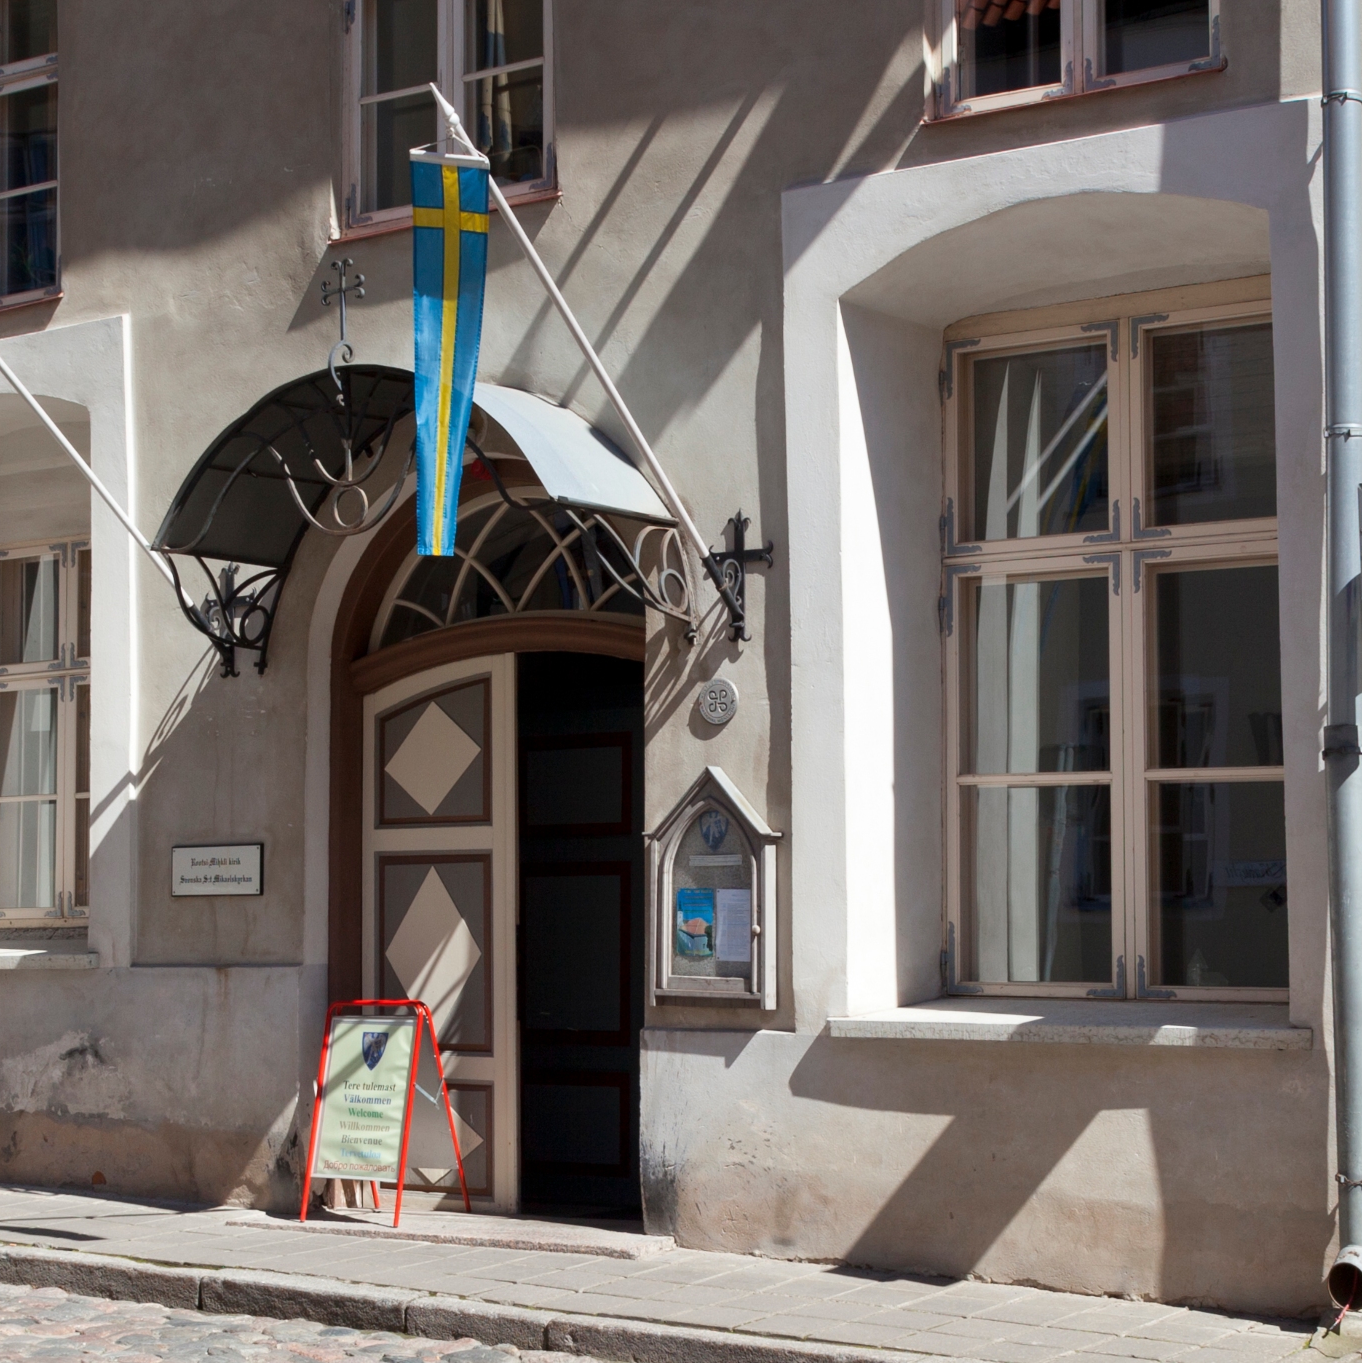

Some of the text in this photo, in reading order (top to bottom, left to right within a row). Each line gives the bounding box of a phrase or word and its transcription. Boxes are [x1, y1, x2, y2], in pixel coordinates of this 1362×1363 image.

[344, 1080, 396, 1092] Tere tulemast
[344, 1094, 392, 1105] Välkommen
[348, 1107, 384, 1119] Welcome
[339, 1120, 390, 1132] Willkommen
[341, 1134, 383, 1146] Bienvenue
[340, 1147, 381, 1159] Tervetuloa
[323, 1159, 396, 1173] Добро пожаловать
